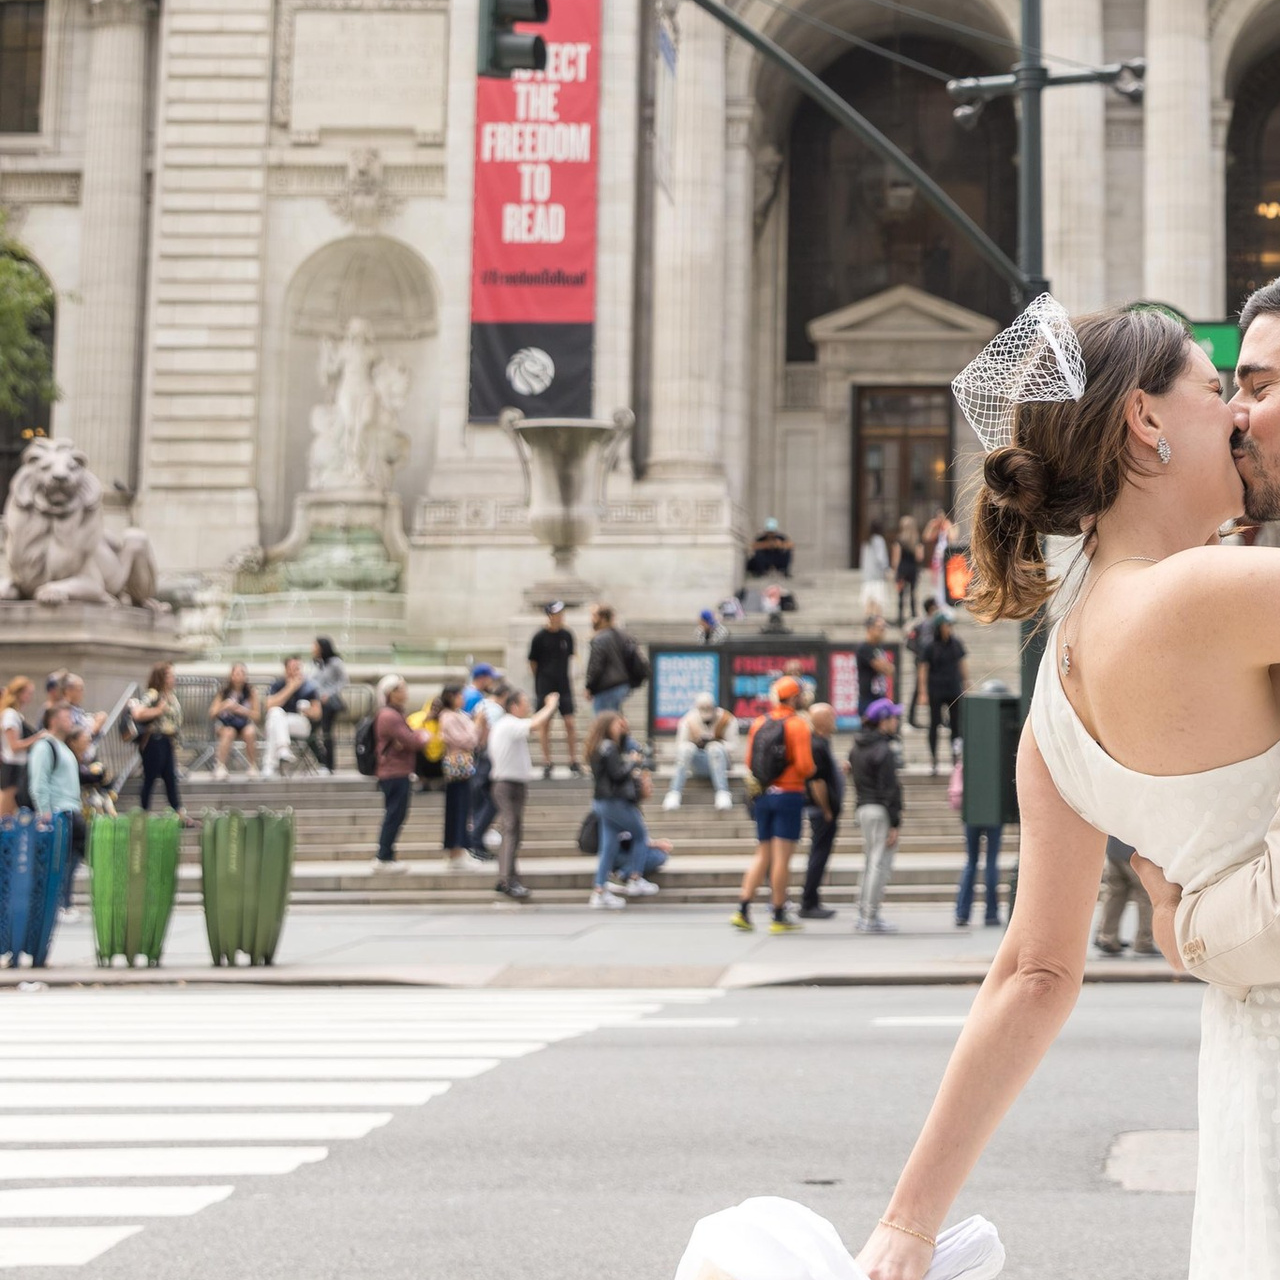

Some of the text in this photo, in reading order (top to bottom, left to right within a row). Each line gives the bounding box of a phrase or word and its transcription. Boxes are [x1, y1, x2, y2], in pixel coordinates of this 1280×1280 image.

[513, 82, 560, 121] THE
[482, 122, 590, 163] FREEDOM
[517, 162, 551, 202] TO
[502, 203, 565, 244] READ
[733, 656, 817, 673] FREEDM
